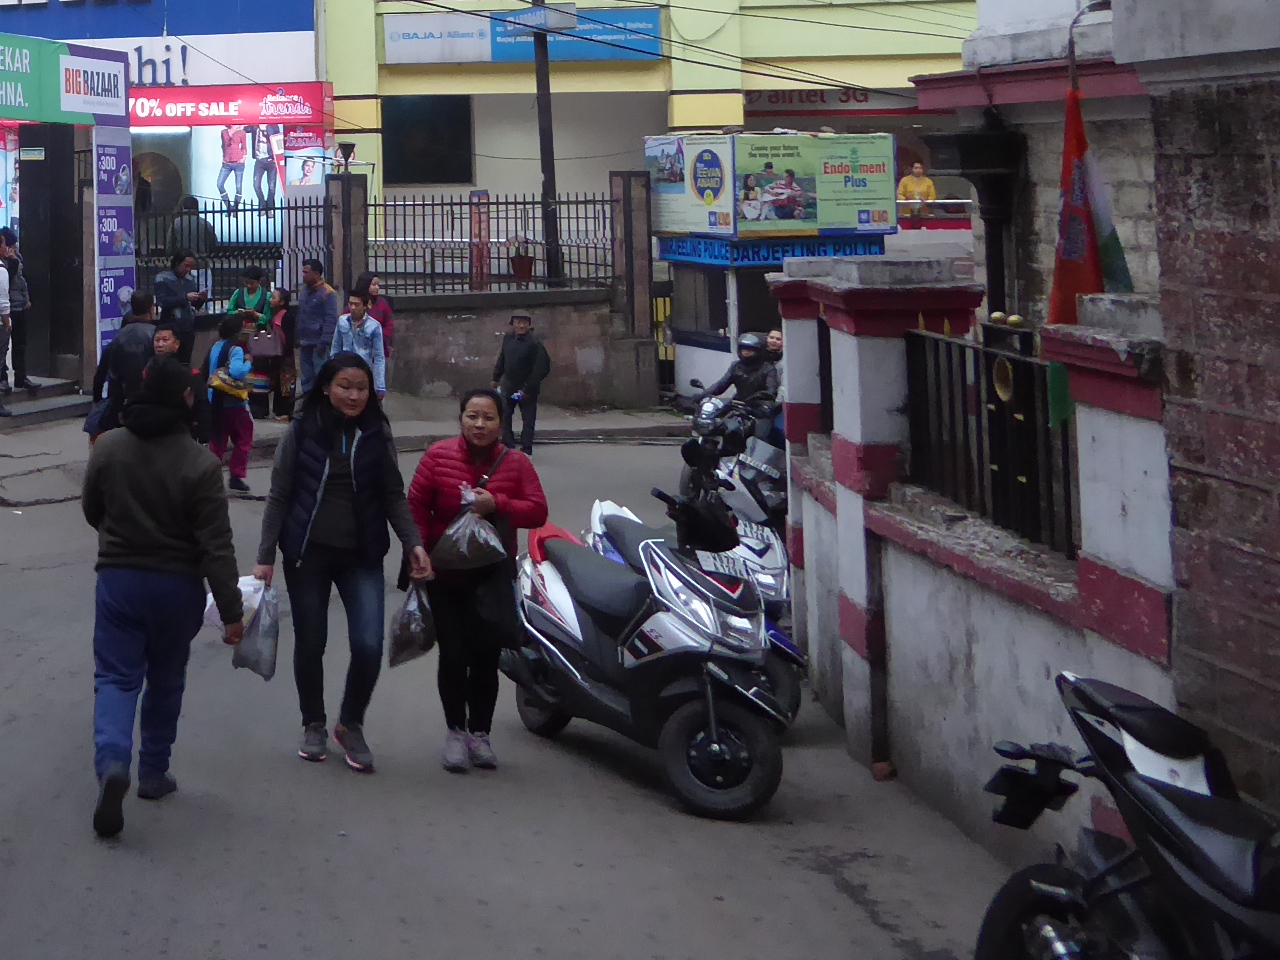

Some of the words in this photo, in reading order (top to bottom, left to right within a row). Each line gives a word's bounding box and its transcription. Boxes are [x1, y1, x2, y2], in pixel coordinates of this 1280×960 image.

[128, 44, 189, 86] hi!
[64, 68, 81, 95] BIG
[82, 70, 119, 98] BAZAAR
[259, 96, 312, 116] trends
[838, 89, 869, 104] 3G
[129, 98, 162, 117] 70%
[165, 102, 195, 117] OFF
[843, 175, 867, 188] Plus
[703, 240, 730, 260] POLICE
[732, 244, 827, 262] DARJEELING
